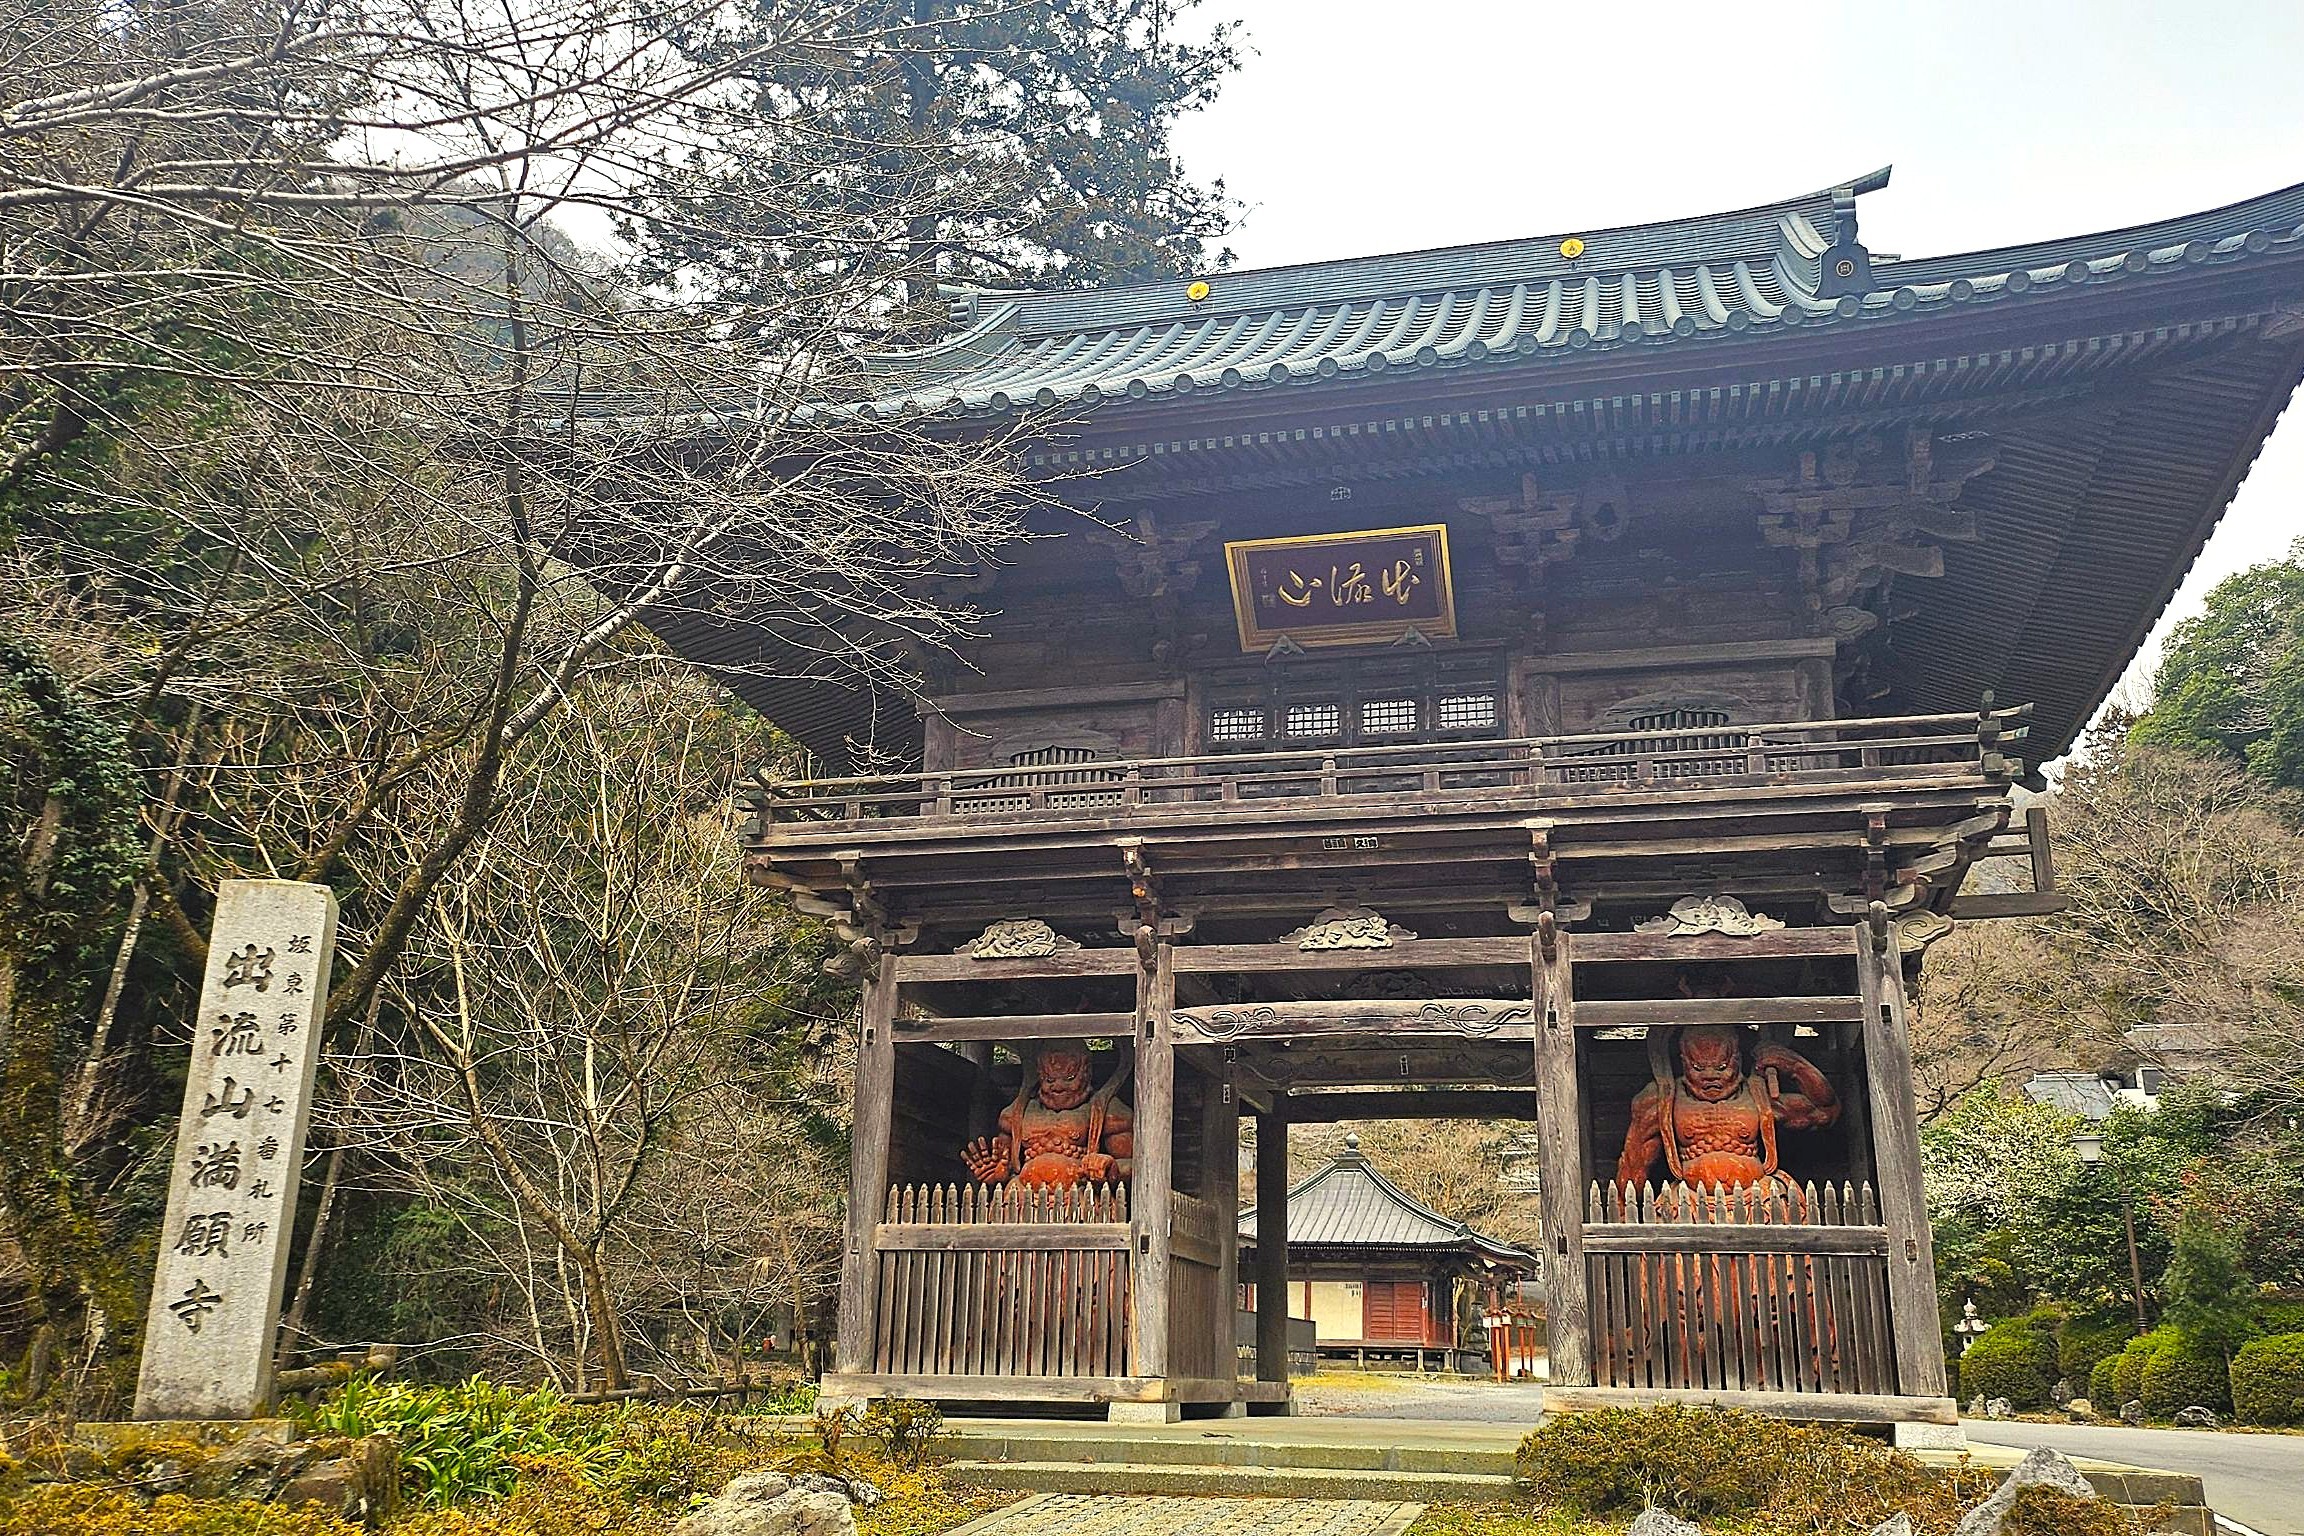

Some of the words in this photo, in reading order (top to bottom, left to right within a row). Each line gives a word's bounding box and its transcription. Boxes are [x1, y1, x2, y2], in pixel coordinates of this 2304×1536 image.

[168, 942, 276, 1336] 出流山満願寺
[241, 934, 312, 1247] 坂東第十七番札所
